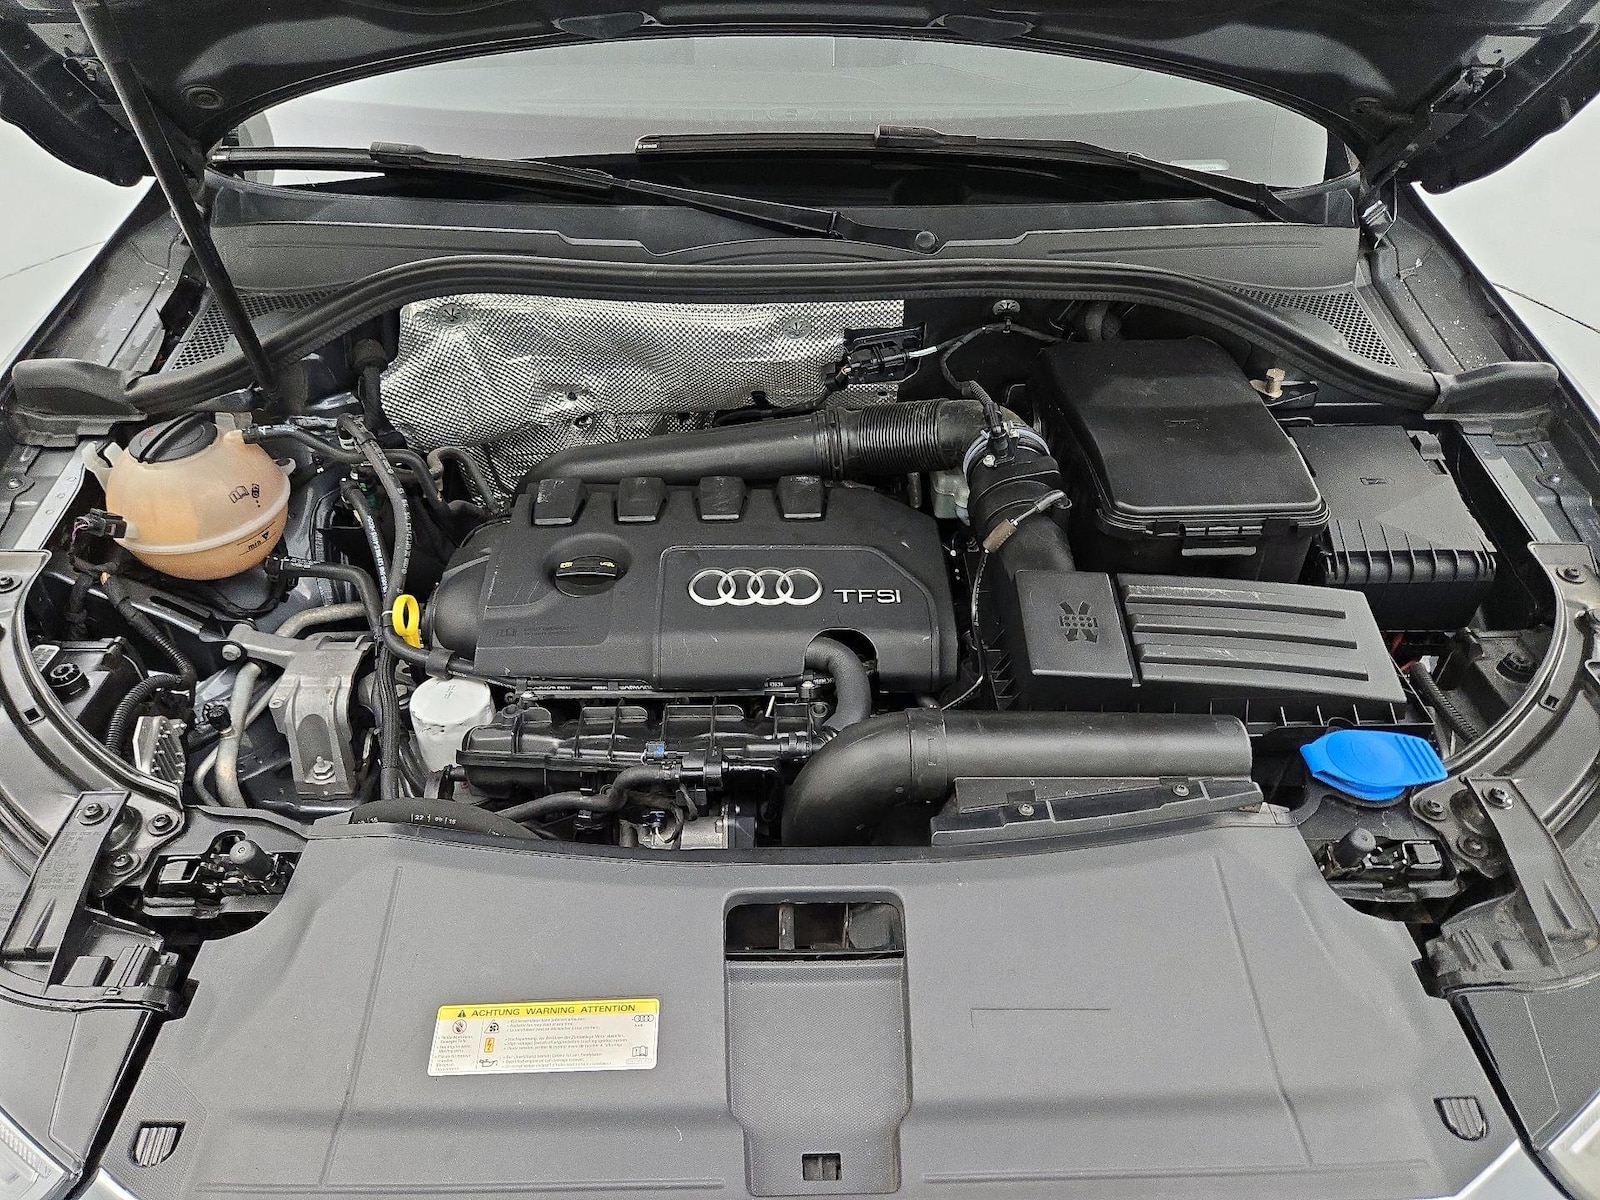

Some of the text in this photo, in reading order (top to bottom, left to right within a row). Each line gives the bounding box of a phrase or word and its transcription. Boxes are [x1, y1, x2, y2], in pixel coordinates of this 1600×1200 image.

[833, 589, 901, 603] TFSI
[472, 1004, 636, 1017] ACHTUNG WARNING ATTENTION
